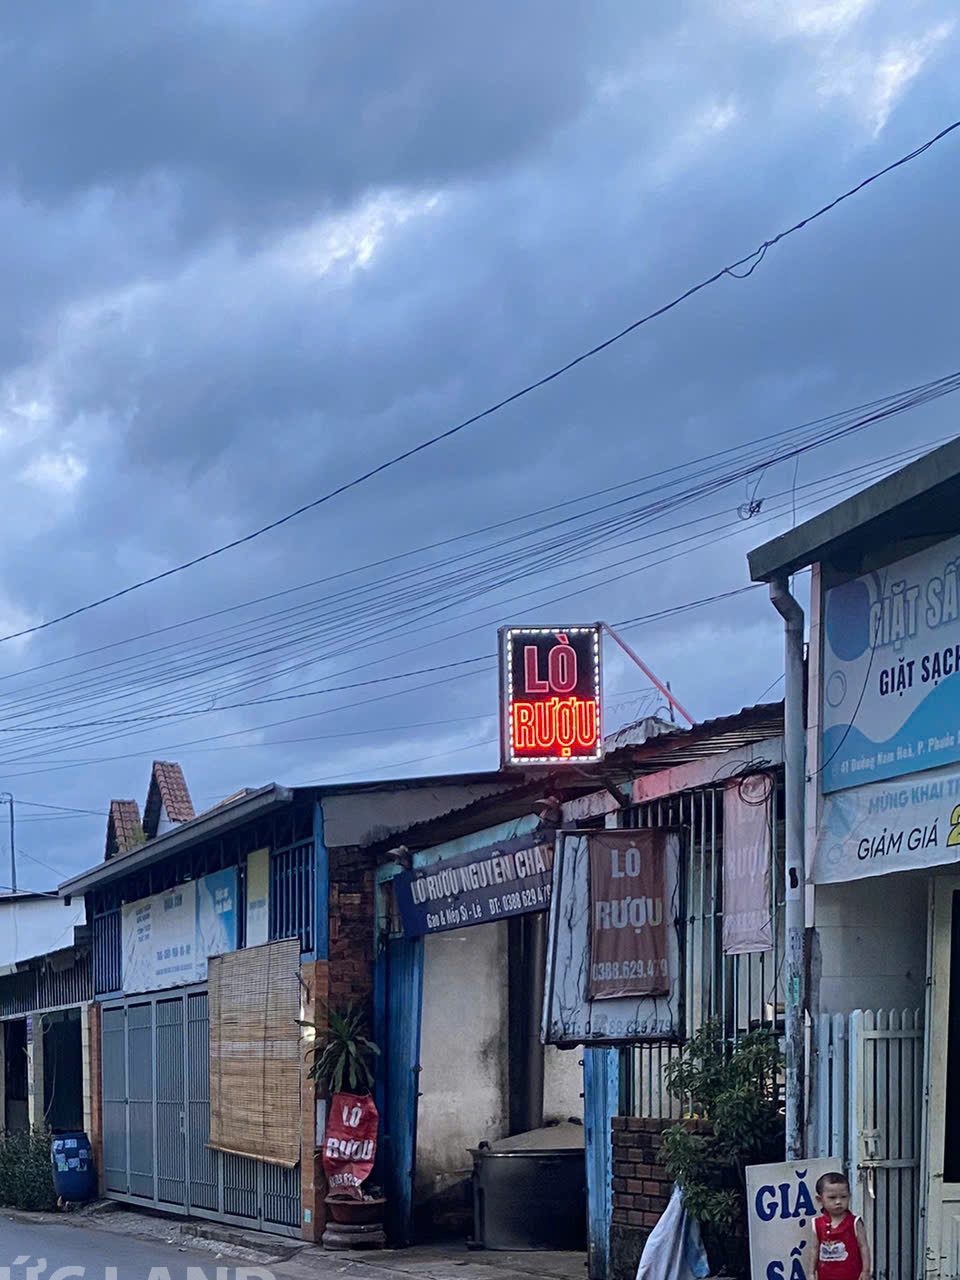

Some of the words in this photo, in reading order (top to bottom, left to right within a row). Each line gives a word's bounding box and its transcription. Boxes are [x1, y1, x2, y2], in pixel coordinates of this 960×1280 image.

[926, 556, 960, 630] SẤ
[524, 634, 577, 693] LÒ
[879, 657, 915, 697] GIẶT
[514, 697, 597, 757] RƯỢU
[911, 781, 944, 806] KHAI
[611, 840, 641, 878] LÒ
[857, 827, 904, 861] GIẢM
[907, 817, 939, 851] GIÁ
[461, 850, 514, 893] NGUYÊN
[595, 895, 663, 934] RƯỢU
[755, 1168, 817, 1228] GIẶ
